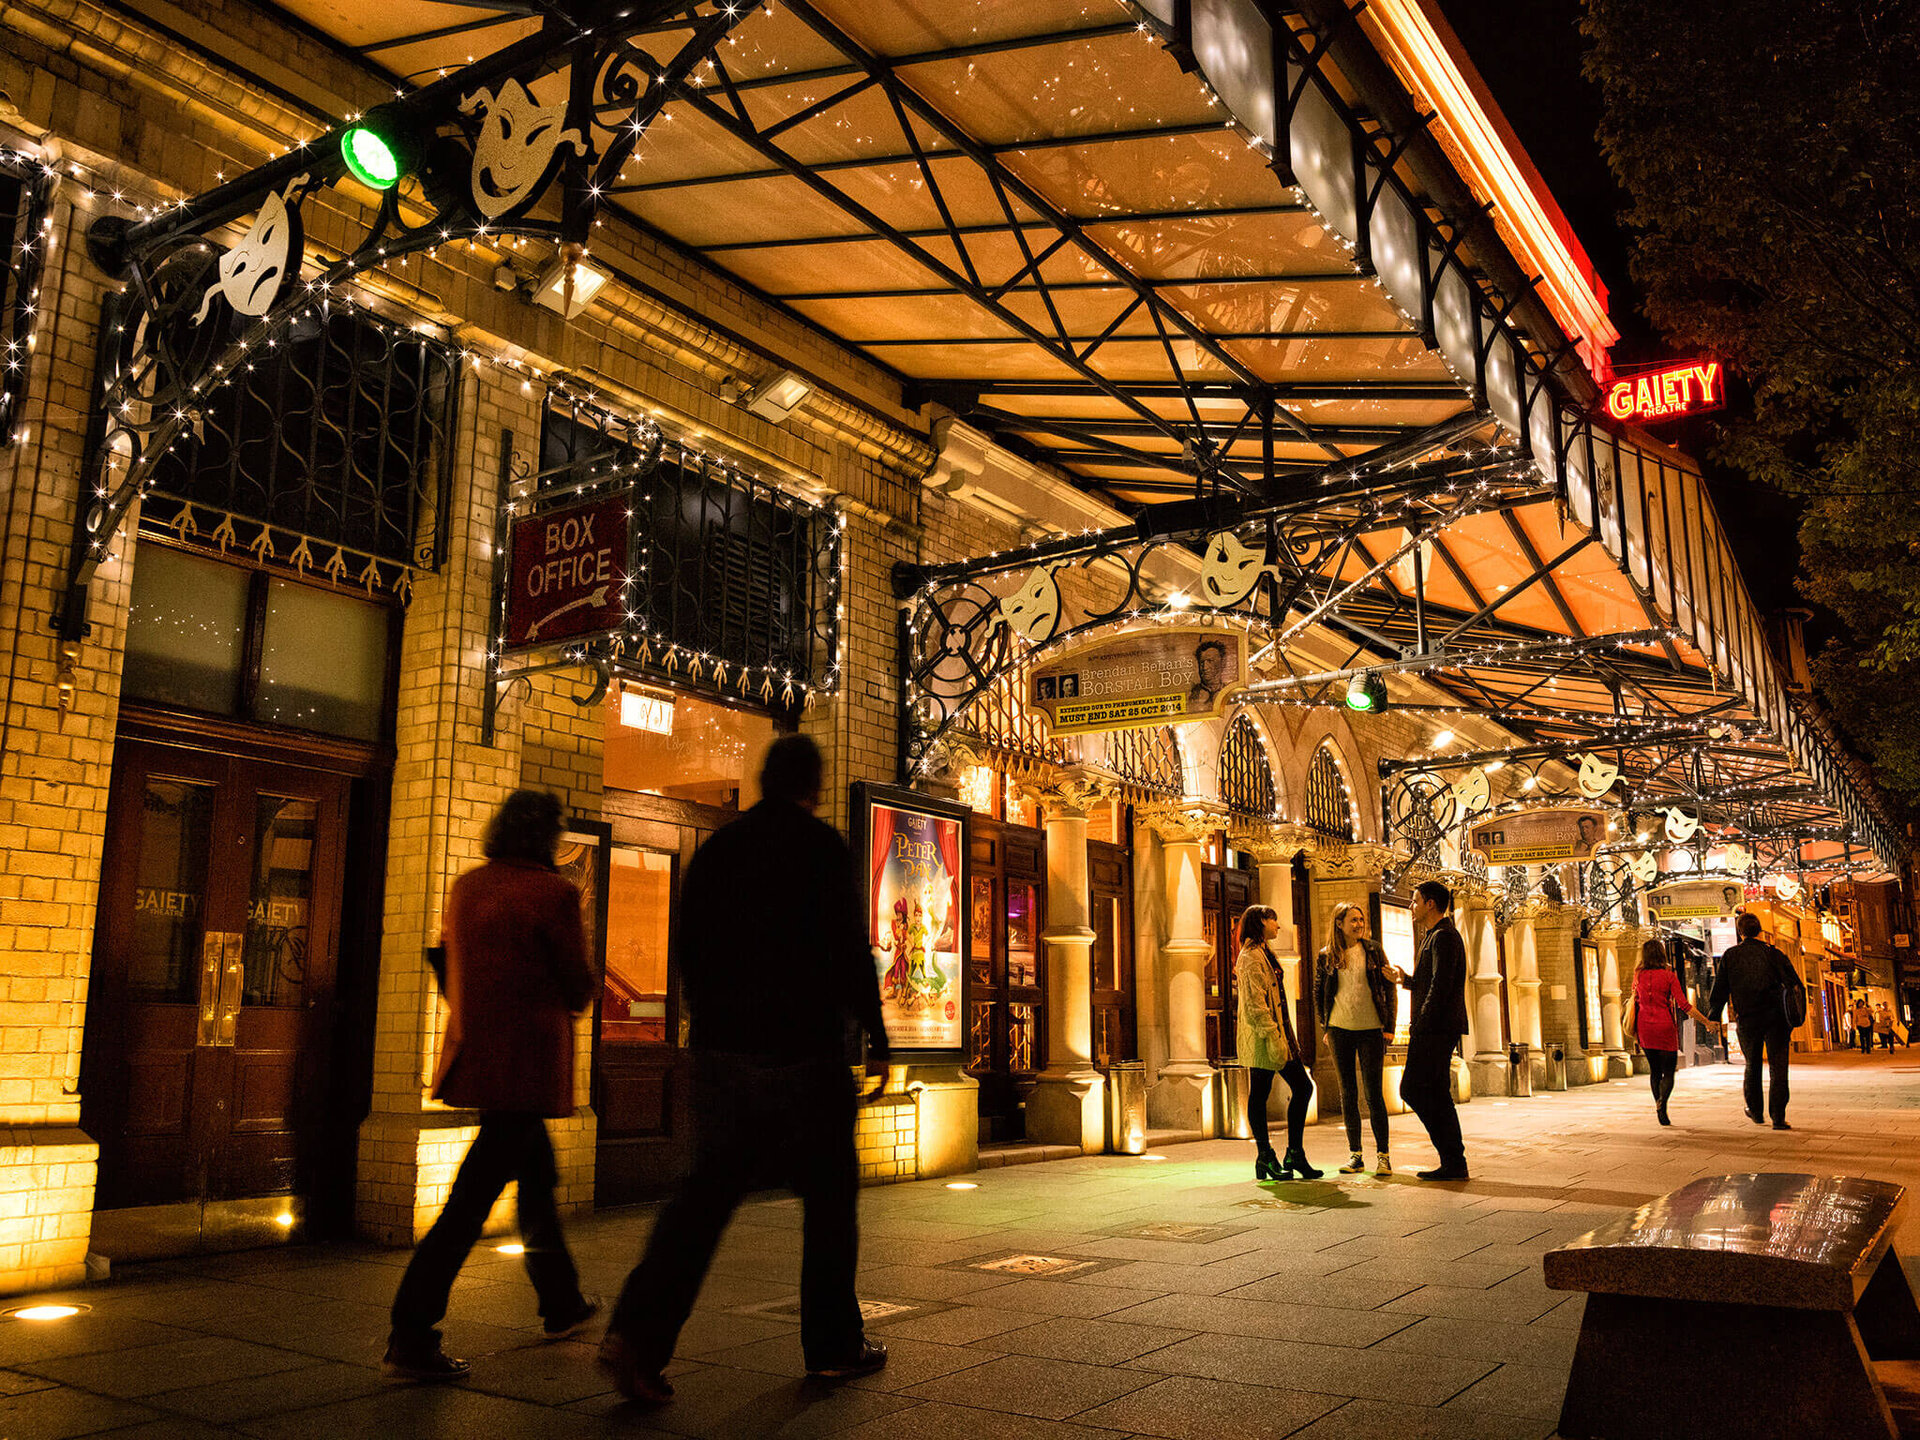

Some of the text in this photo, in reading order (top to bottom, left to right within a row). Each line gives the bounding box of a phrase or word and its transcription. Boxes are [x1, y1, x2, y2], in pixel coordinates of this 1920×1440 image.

[1609, 363, 1717, 419] GAIETY
[1643, 402, 1687, 418] THEATRE
[545, 513, 595, 555] BOX
[527, 548, 612, 597] OFFICE
[1081, 666, 1136, 681] Brendan
[1141, 657, 1193, 673] Behan's
[1081, 671, 1193, 697] BORSTAL BOY
[1059, 703, 1182, 723] MUST END SAT 25 OCT 2014
[1060, 704, 1090, 714] EXTENDED
[1091, 703, 1103, 711] DUE
[1112, 698, 1154, 708] PHENOMENAL
[1155, 695, 1182, 704] DEMAND
[894, 832, 941, 868] PETER
